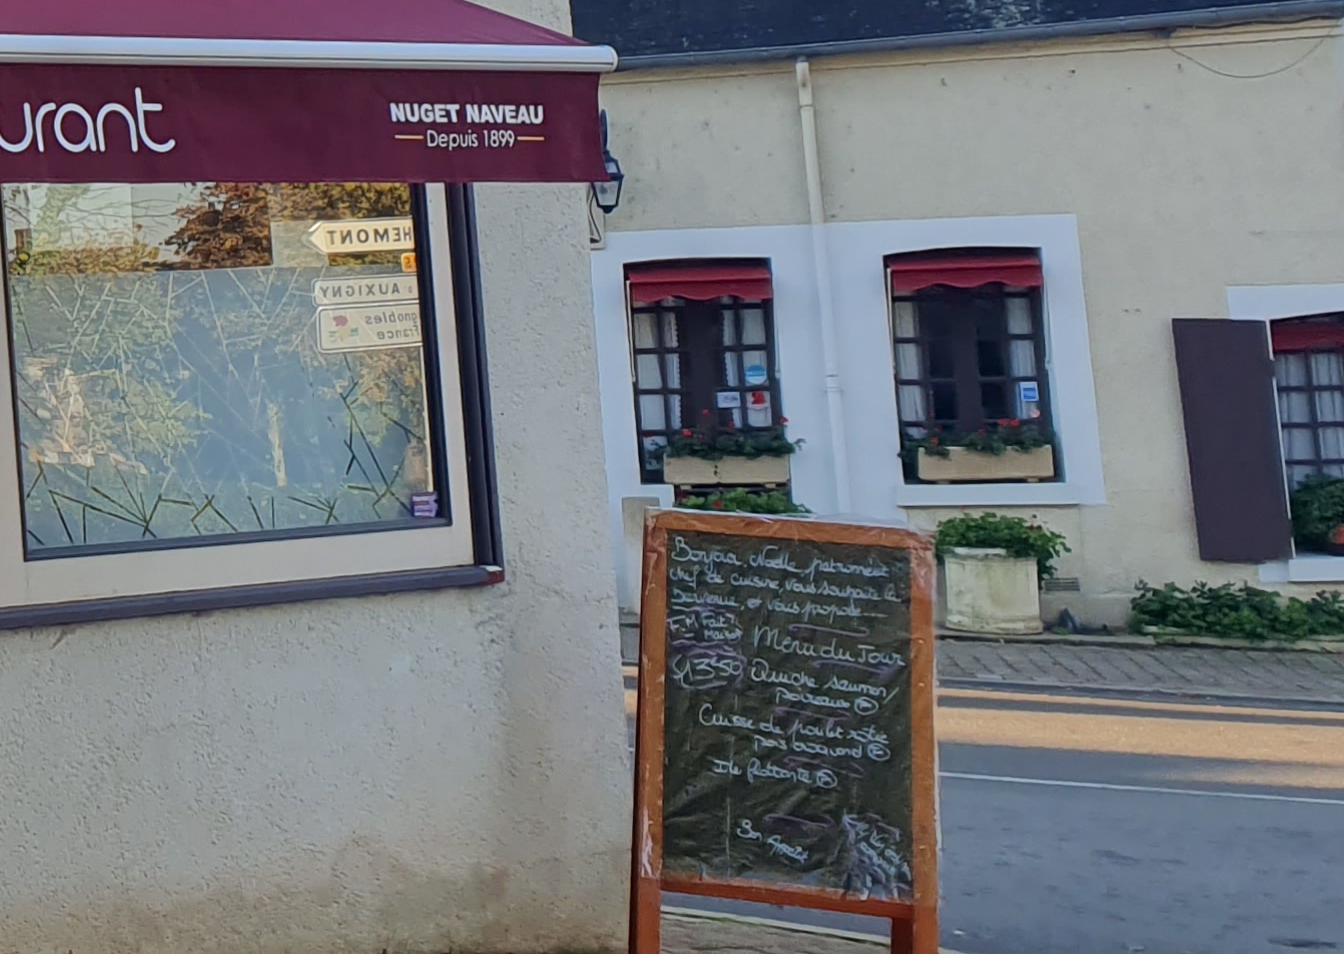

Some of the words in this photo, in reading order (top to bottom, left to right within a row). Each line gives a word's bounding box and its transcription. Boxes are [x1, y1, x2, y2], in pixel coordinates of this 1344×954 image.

[389, 103, 460, 123] NUGET
[465, 104, 544, 124] NAVEAU
[426, 129, 478, 151] Depuis
[483, 129, 515, 148] 1899
[754, 625, 817, 656] Menu
